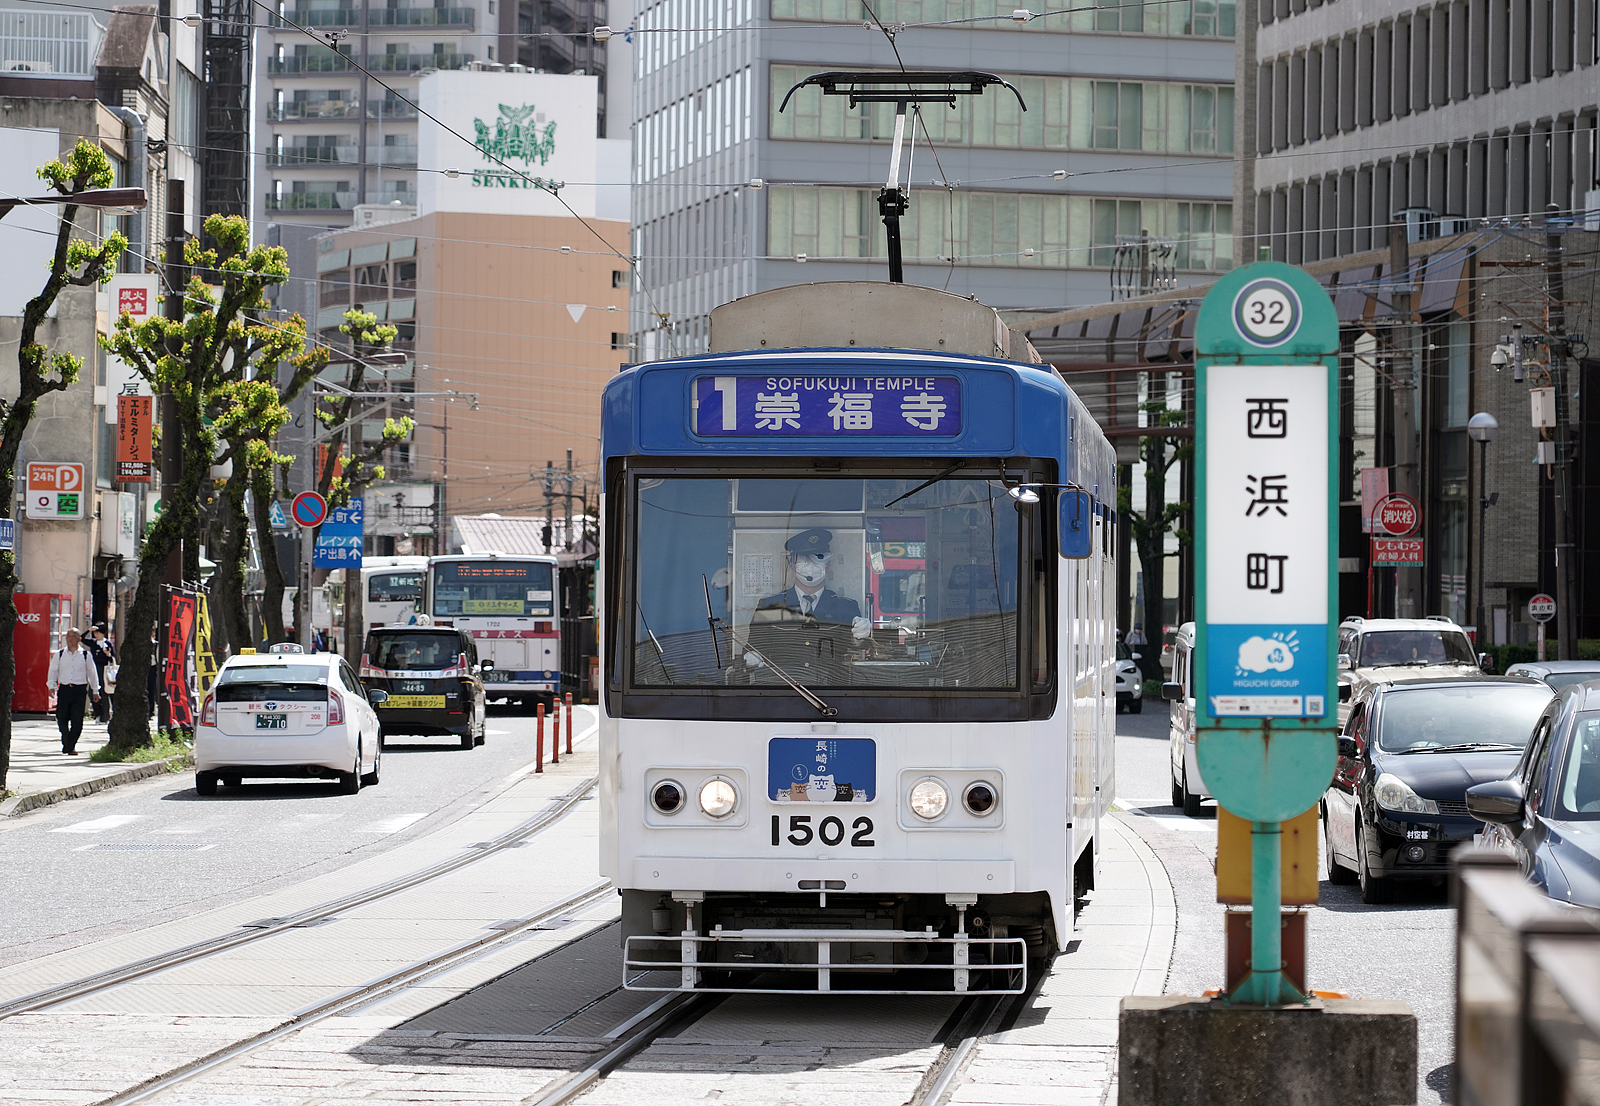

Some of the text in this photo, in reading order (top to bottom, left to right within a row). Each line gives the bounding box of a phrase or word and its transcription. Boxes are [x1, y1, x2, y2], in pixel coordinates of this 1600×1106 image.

[1250, 301, 1285, 324] 32
[766, 377, 935, 391] SOFUKUJI TEMPLE
[714, 376, 737, 431] 1
[754, 392, 947, 431] 崇福寺
[129, 399, 140, 461] エルミタージュ
[32, 466, 79, 490] 24h P
[57, 493, 79, 515] 空
[1245, 398, 1289, 594] 西浜町
[1383, 509, 1412, 524] 消火栓
[883, 542, 906, 557] 5
[1375, 541, 1421, 551] しもむら
[1377, 551, 1419, 561] 産婦人科
[1234, 680, 1300, 688] HIGUCHI GROUP
[815, 740, 828, 773] 長崎の
[771, 815, 875, 847] 1502
